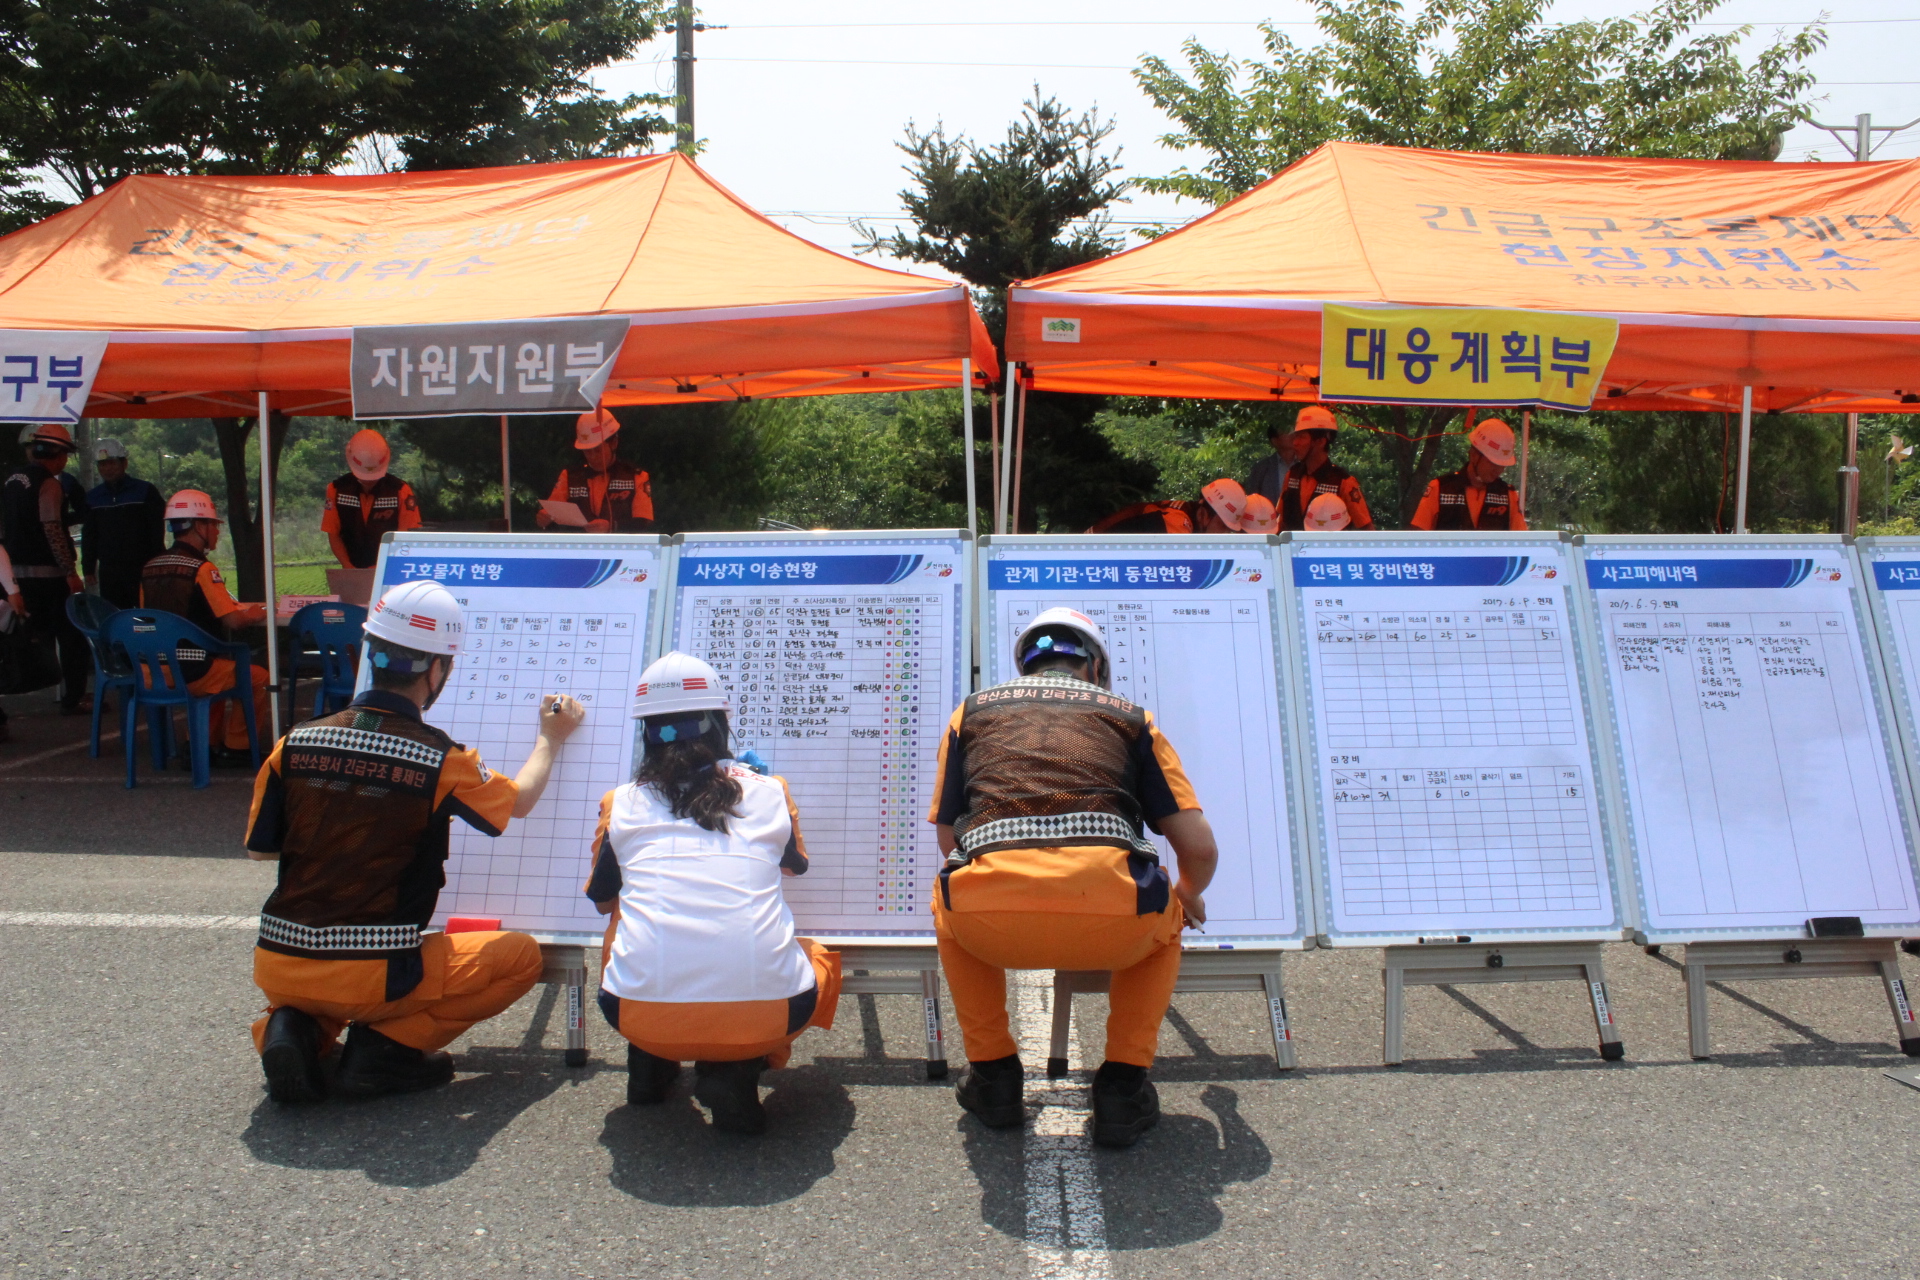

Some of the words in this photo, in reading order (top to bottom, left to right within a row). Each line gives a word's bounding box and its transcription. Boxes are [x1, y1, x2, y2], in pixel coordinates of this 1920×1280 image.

[1415, 203, 1919, 242] 긴급구조통제단
[1501, 243, 1881, 272] 현장지휘소
[161, 254, 496, 287] 현장지휘소
[1572, 273, 1862, 292] 전주완산소방서
[1345, 326, 1590, 388] 대응계획부
[371, 342, 604, 397] 자원지원부
[401, 563, 466, 580] 구호물자
[470, 564, 503, 581] 현황
[694, 563, 745, 580] 사상자
[750, 562, 818, 579] 이송현황
[1004, 567, 1039, 583] 관계
[1045, 566, 1119, 583] 기관·단체
[1124, 565, 1193, 583] 동원현황
[1309, 564, 1342, 580] 인력
[1348, 564, 1364, 580] 및
[1369, 563, 1435, 580] 장비현황
[1602, 566, 1698, 582] 사고피해내역
[1889, 567, 1920, 584] 사고
[1537, 597, 1554, 605] 현재
[1663, 600, 1679, 609] 현재
[446, 622, 462, 633] 119
[1358, 632, 1376, 640] 260
[1415, 632, 1426, 641] 60
[1440, 631, 1453, 640] 25
[1541, 629, 1554, 640] 51
[475, 638, 483, 648] 3
[554, 674, 566, 683] 10
[764, 673, 775, 681] 26
[467, 691, 475, 700] 5
[576, 693, 592, 701] 100
[976, 689, 1037, 705] 완산소방서
[1042, 689, 1092, 701] 긴급구조
[1096, 694, 1134, 713] 통제단
[290, 753, 342, 773] 완산소방서
[344, 758, 389, 779] 긴급구조
[391, 766, 426, 788] 통제단
[1435, 790, 1442, 798] 6
[1460, 790, 1470, 798] 10
[1566, 787, 1578, 797] 15
[1892, 981, 1910, 1021] 전주완산소방서
[927, 1000, 936, 1040] 전주완산소방서
[1273, 999, 1285, 1040] 전주완산소방서
